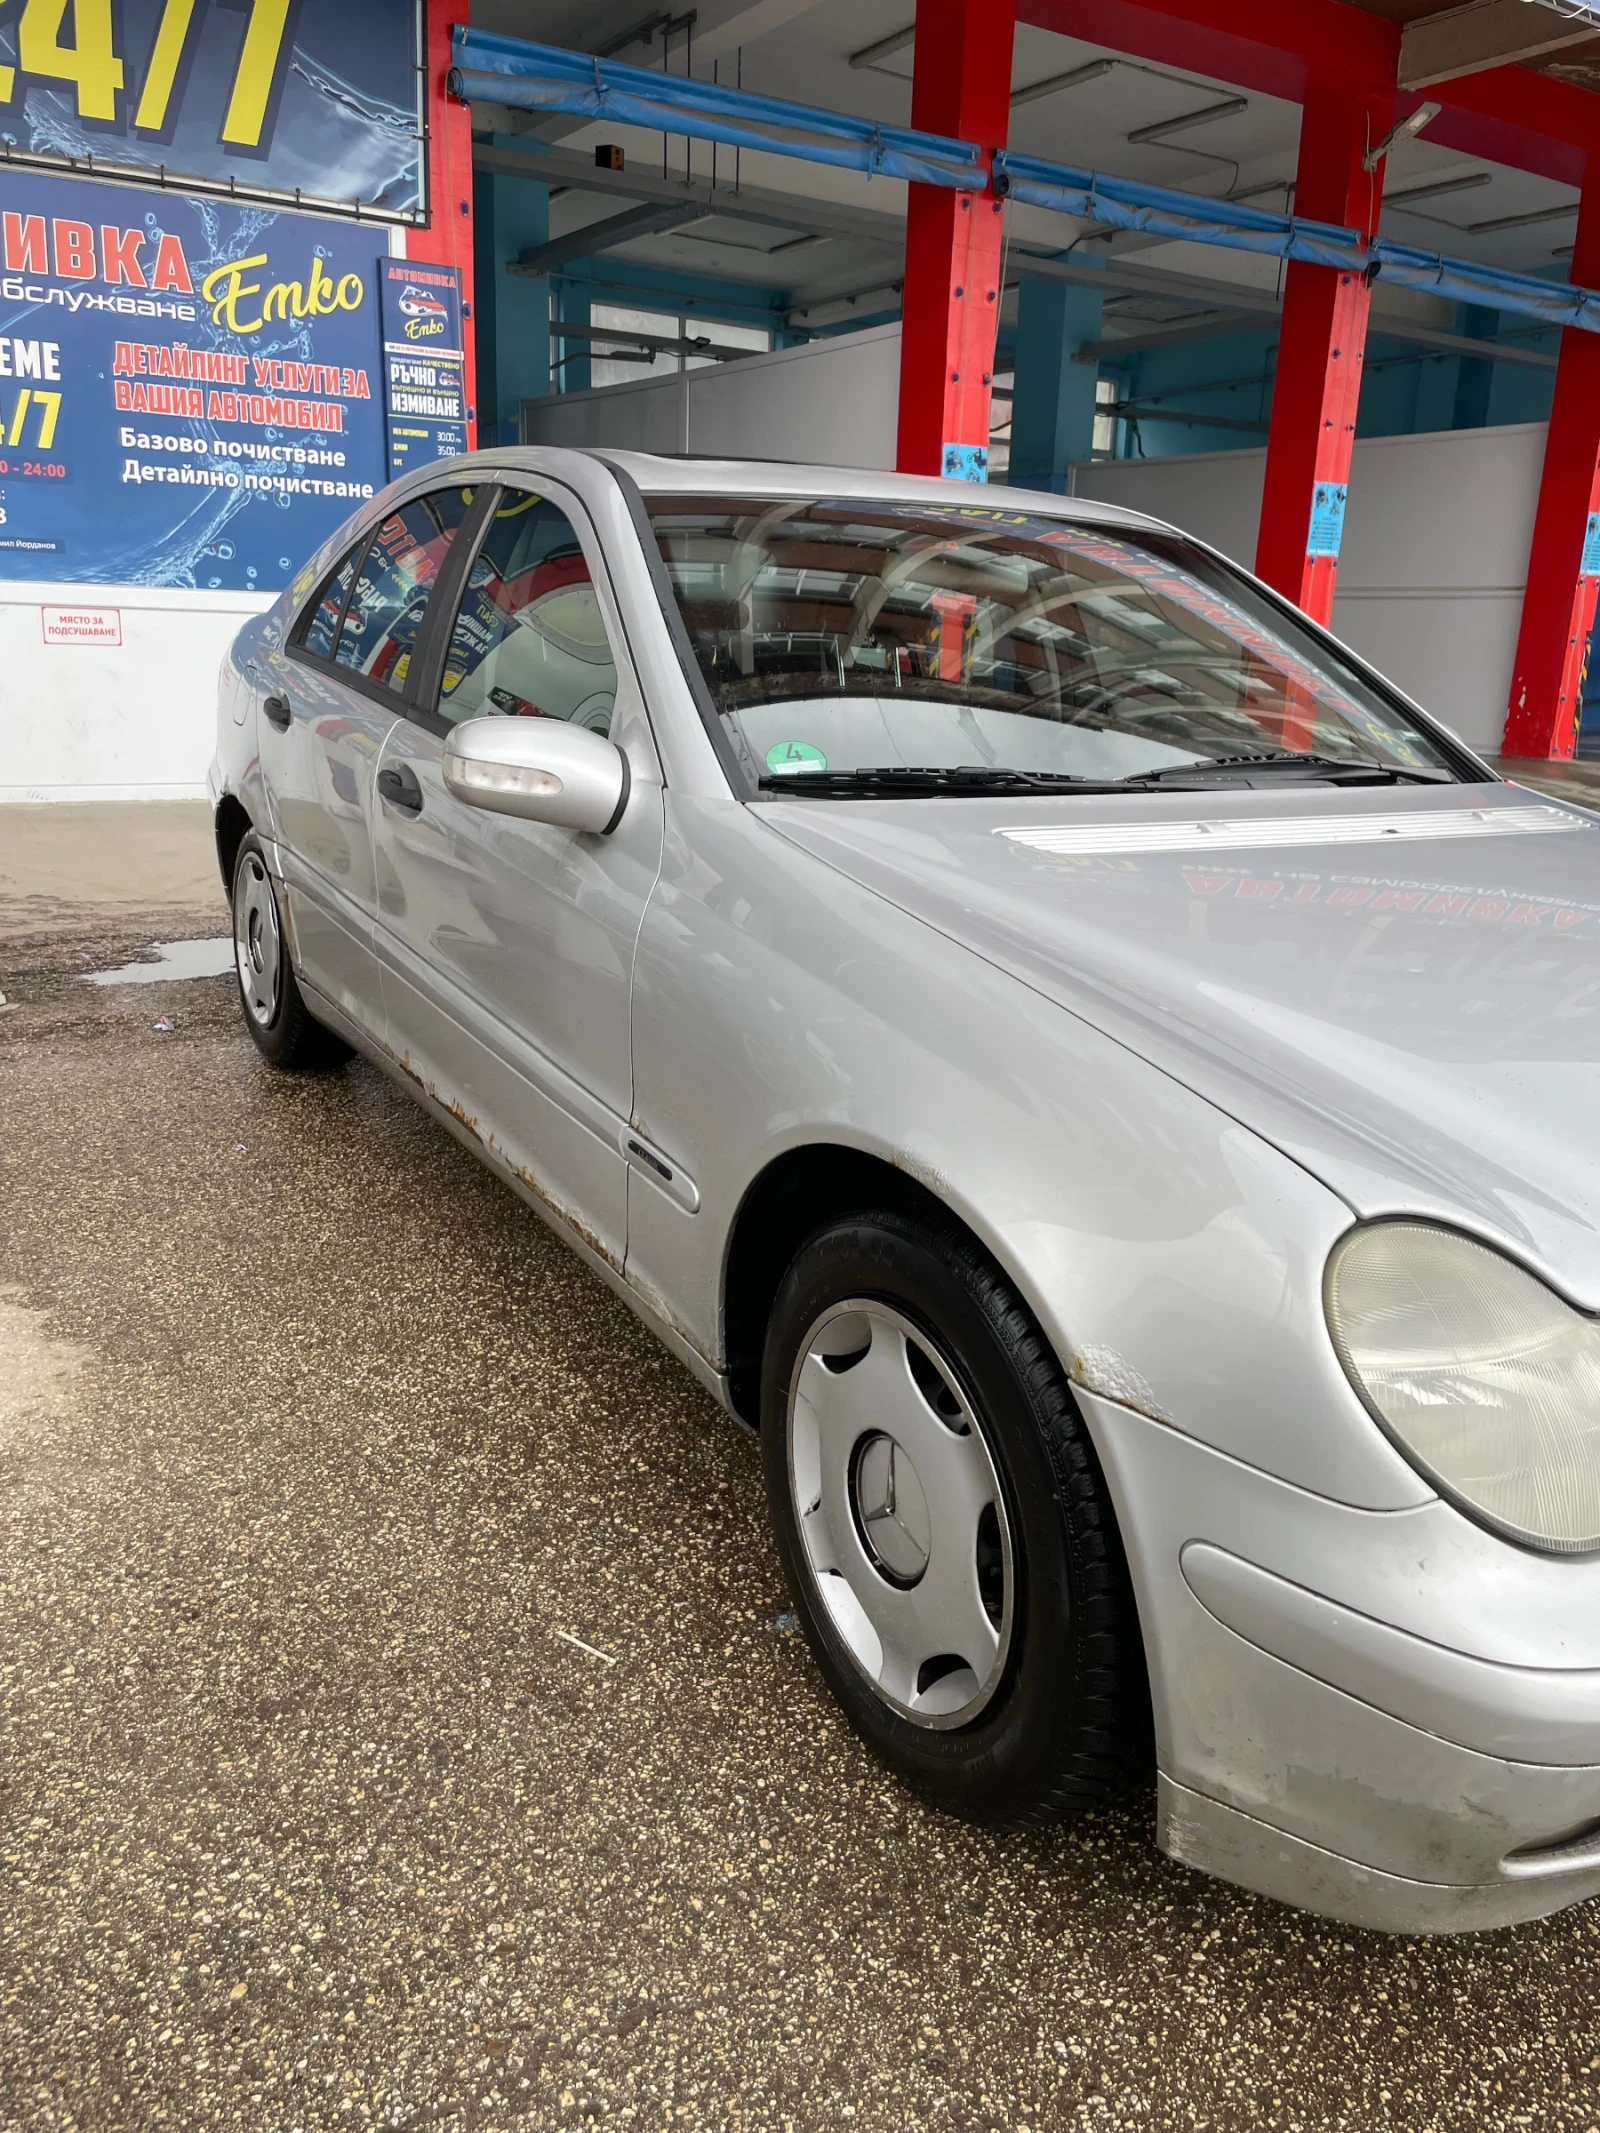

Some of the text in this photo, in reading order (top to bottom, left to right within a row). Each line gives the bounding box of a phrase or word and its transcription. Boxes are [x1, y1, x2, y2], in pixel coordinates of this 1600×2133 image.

[3, 211, 195, 294] ИВКА
[388, 267, 457, 288] АВТОМИВКА
[0, 277, 196, 322] бслужване
[113, 341, 371, 399] ДЕТАЙЛИНГ УСЛУГИ ЗА
[390, 364, 436, 387] РЪЧНО
[0, 388, 62, 449] /7
[114, 380, 343, 433] ВАШИЯ АВТОМОБИЛ
[391, 392, 460, 417] ИЗМИВАНЕ
[120, 427, 346, 467] Базово почистване
[23, 462, 66, 478] 24:00
[122, 459, 374, 499] Детайлно почистване
[48, 626, 117, 637] ПОДСУШАВАНЕ
[59, 616, 104, 625] МЯСТО ЗА
[786, 743, 803, 761] 4
